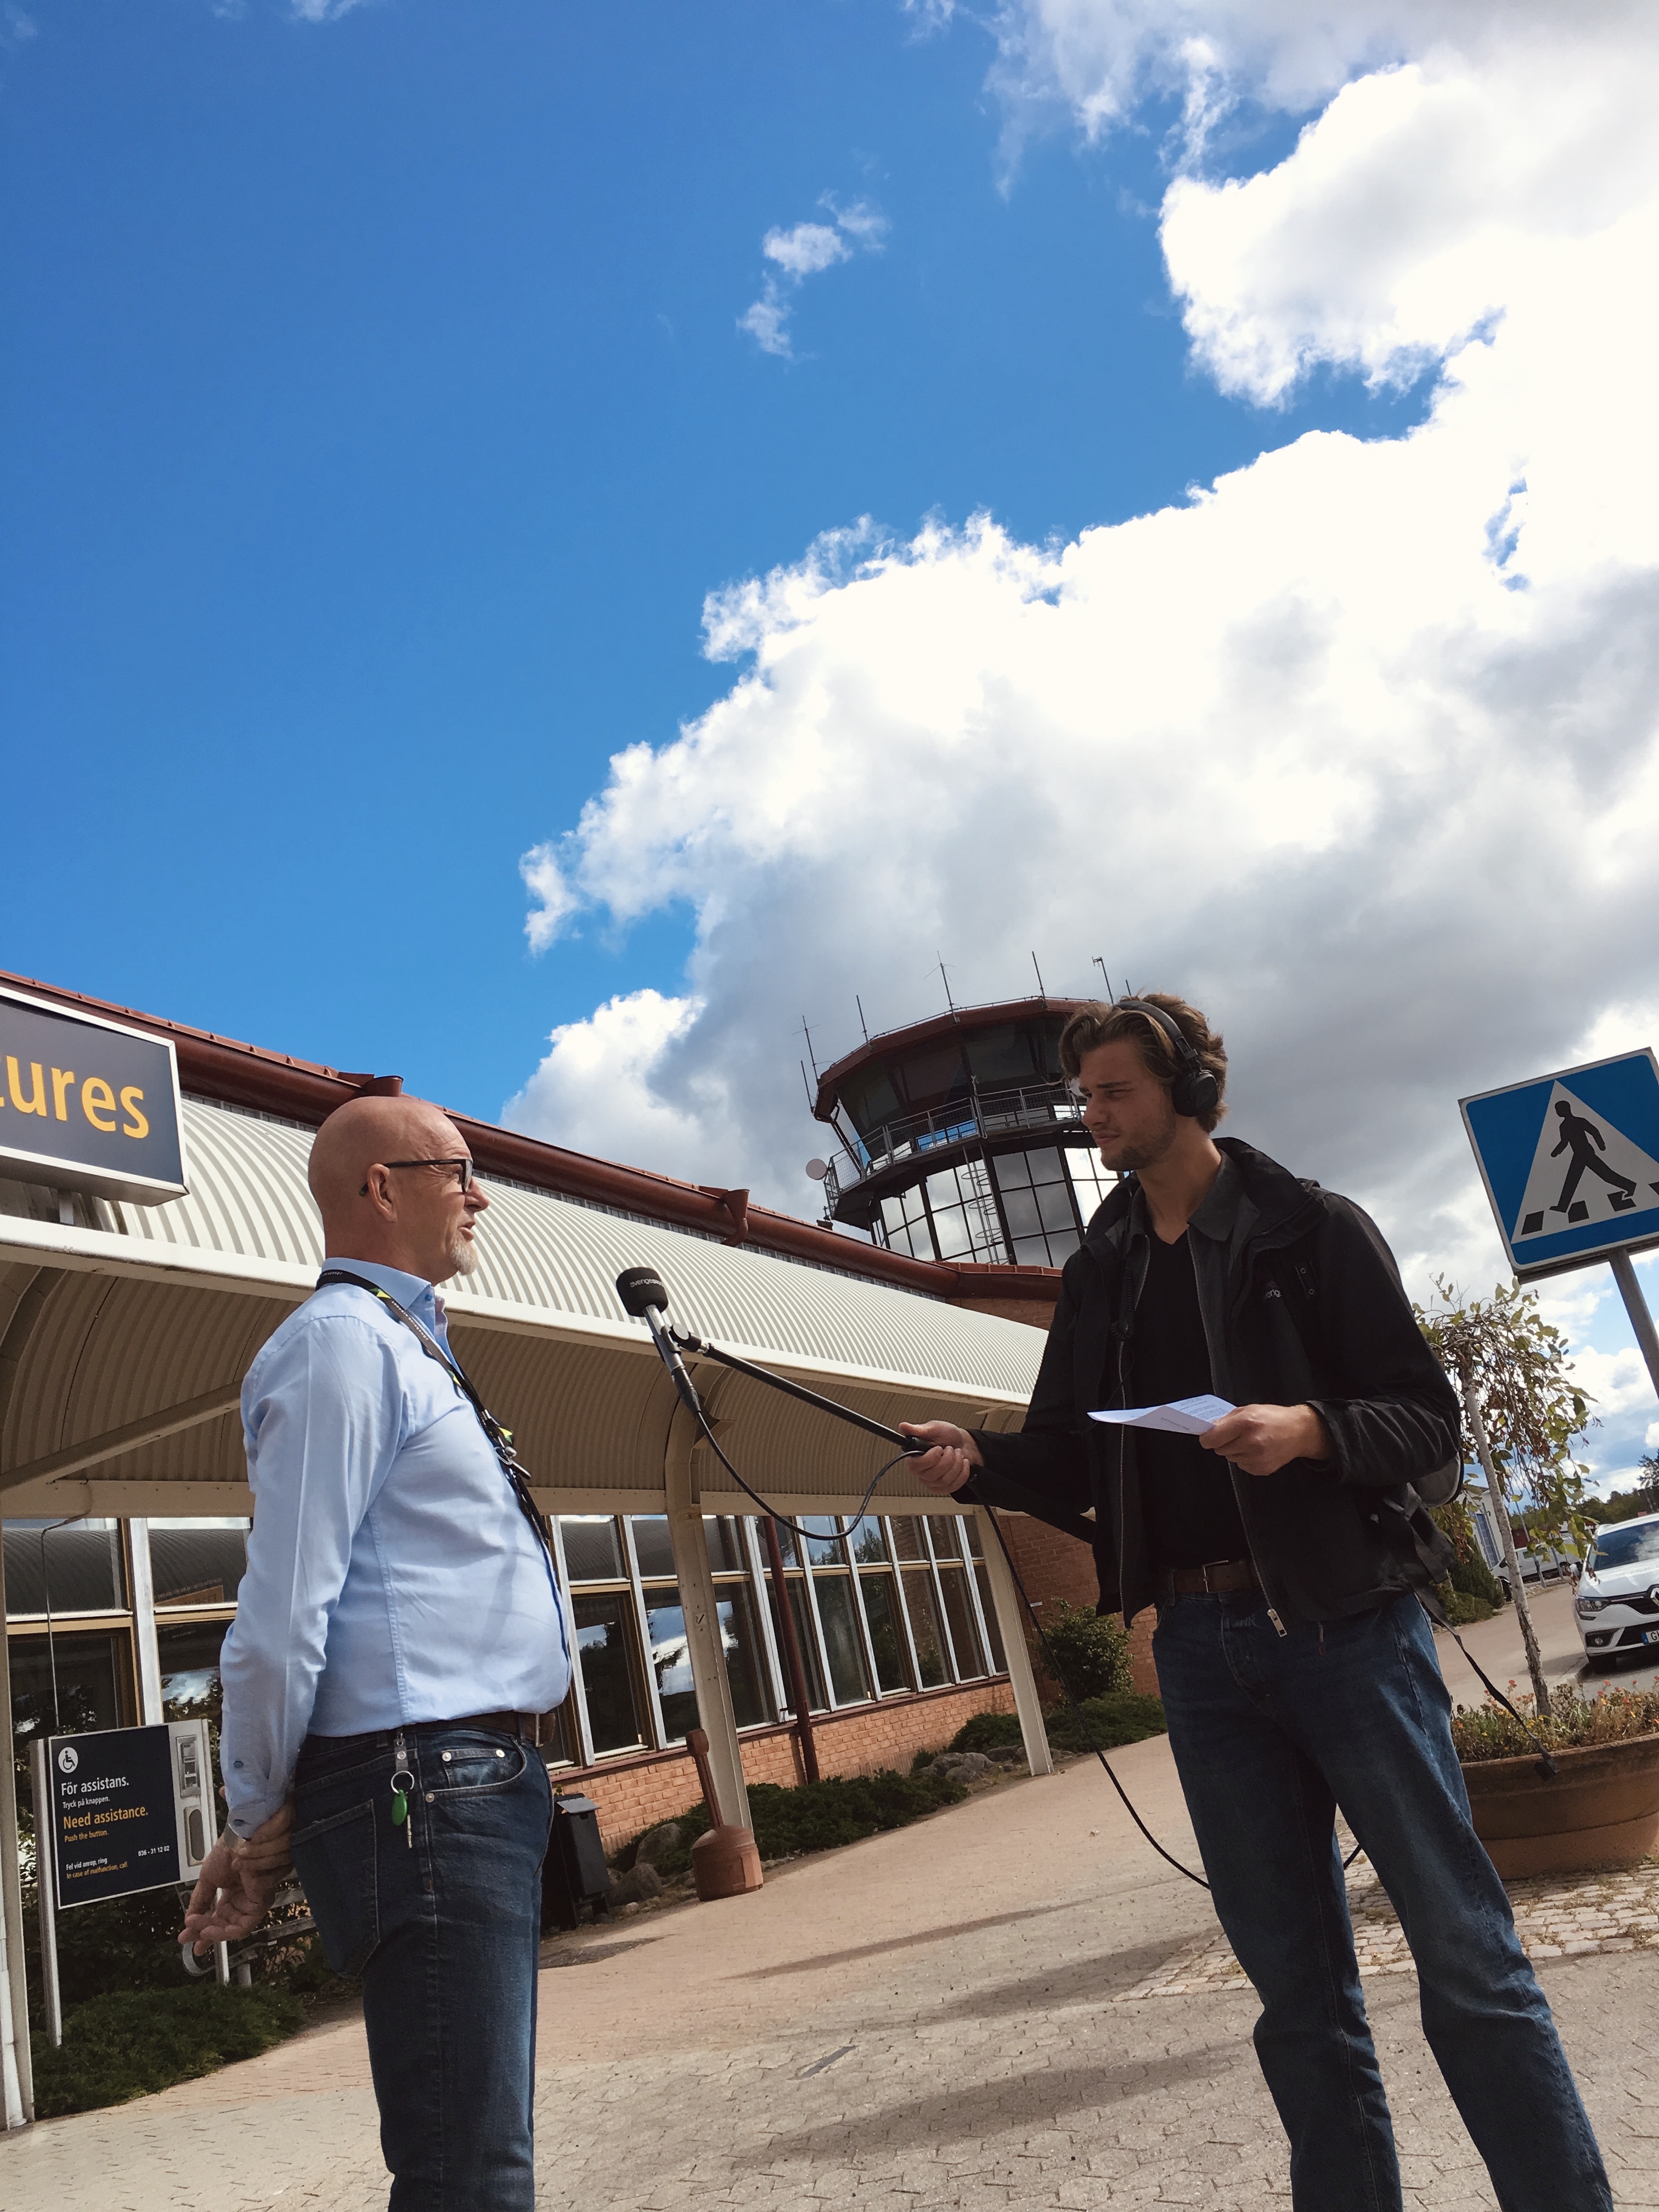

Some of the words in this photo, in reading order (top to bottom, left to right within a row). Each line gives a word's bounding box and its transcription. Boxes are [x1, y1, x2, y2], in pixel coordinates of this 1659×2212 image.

[0, 1056, 149, 1138] ures
[61, 1781, 78, 1796] För
[81, 1776, 129, 1793] assistans.
[63, 1800, 76, 1810] Tryck
[77, 1798, 85, 1808] på
[86, 1796, 110, 1805] knappen.
[63, 1812, 91, 1830] Need
[94, 1806, 149, 1824] assistance.
[64, 1834, 77, 1842] Push
[78, 1832, 88, 1840] the
[89, 1830, 109, 1838] button.
